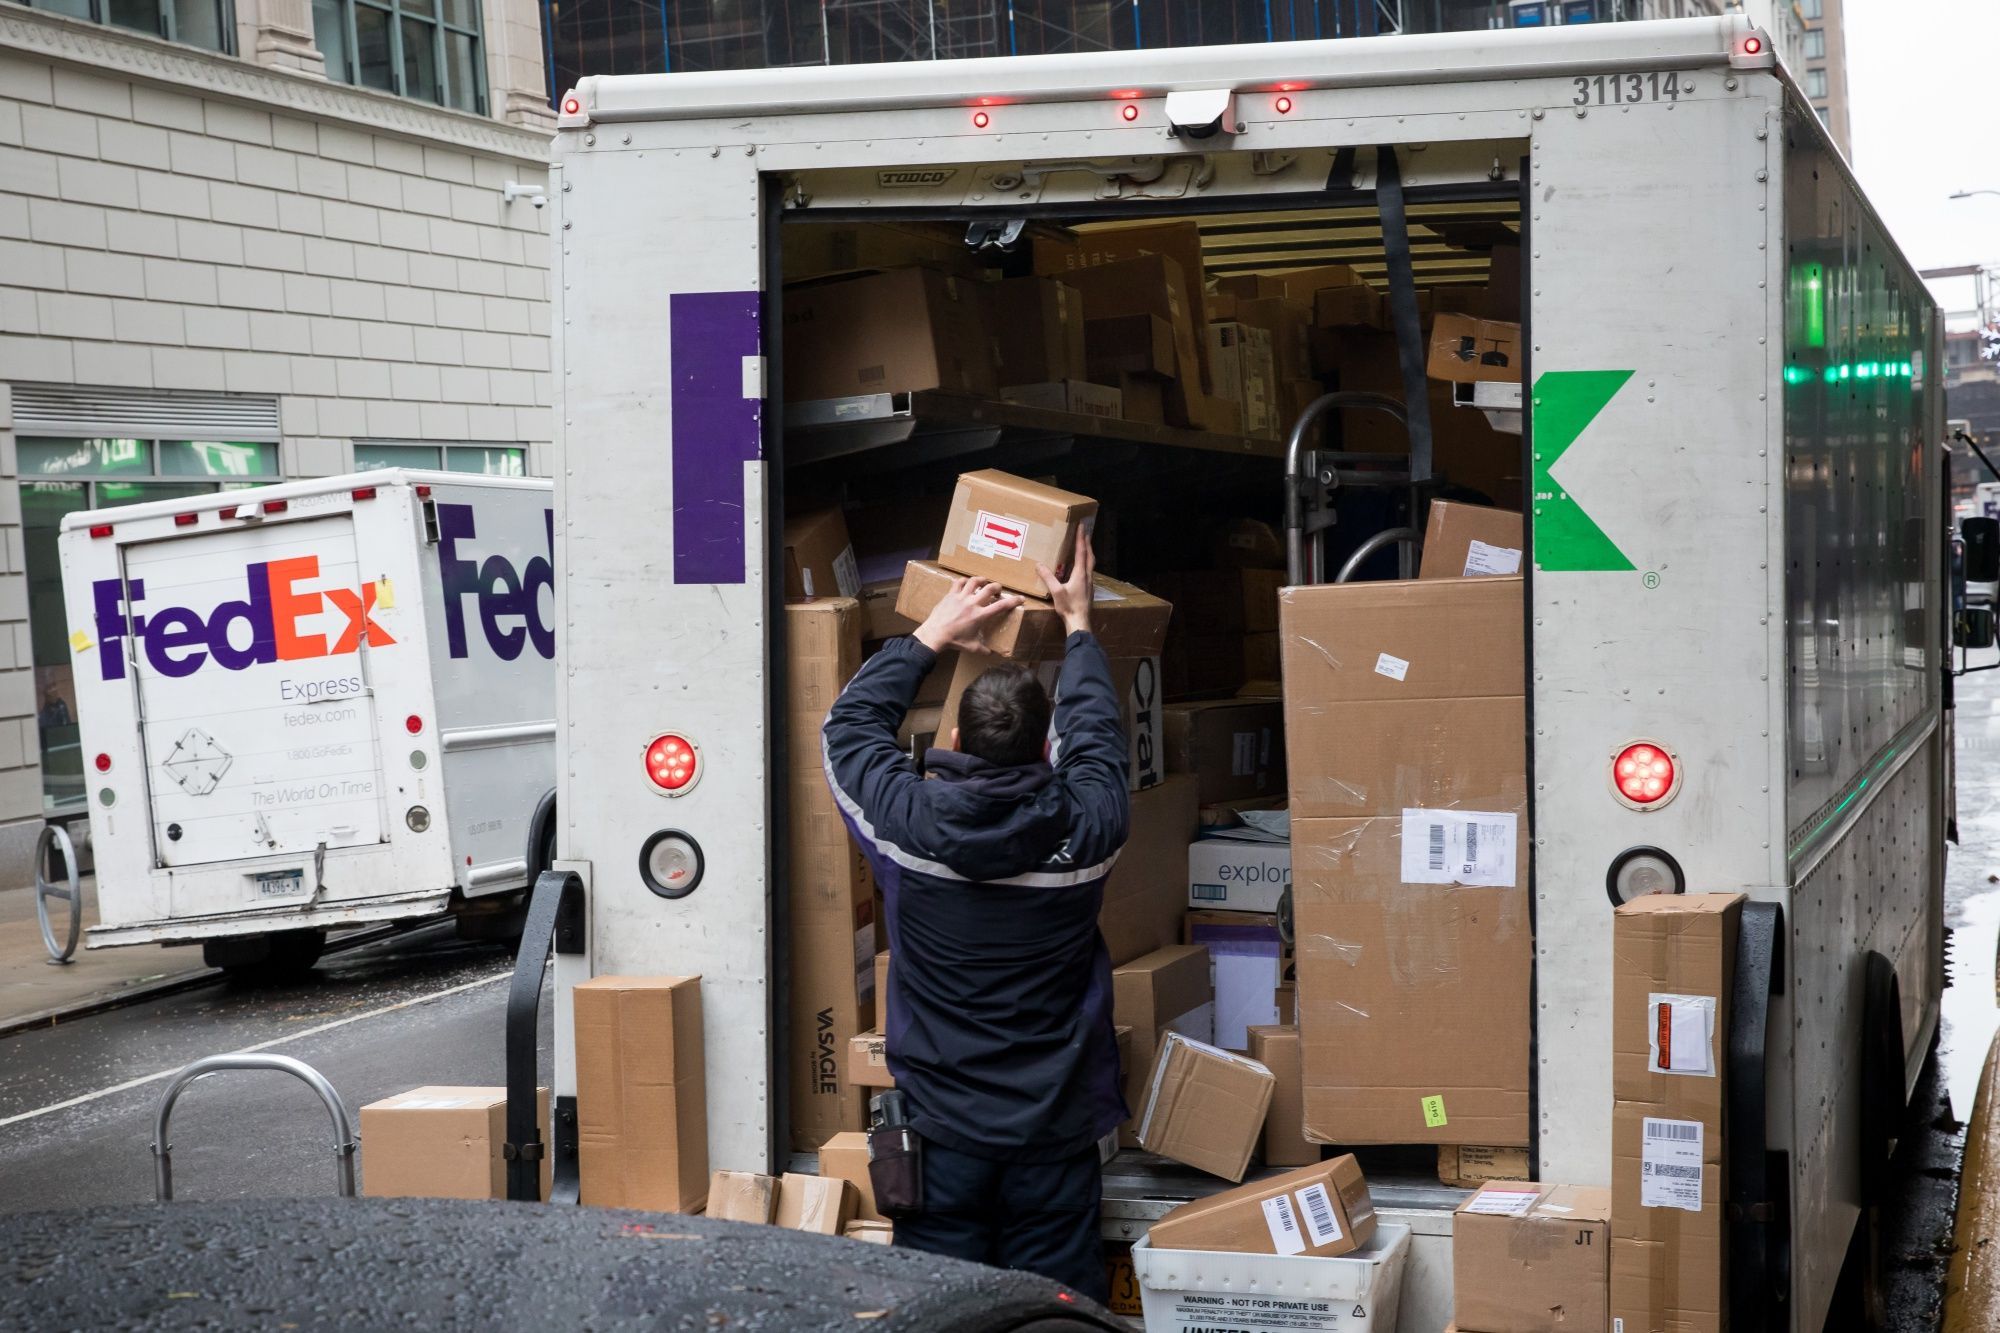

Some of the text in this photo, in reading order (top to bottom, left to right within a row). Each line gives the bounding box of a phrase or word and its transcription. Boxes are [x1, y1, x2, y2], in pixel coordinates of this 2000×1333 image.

[1573, 72, 1679, 106] 311314
[883, 172, 945, 184] TODCO
[92, 554, 398, 681] FedEx
[280, 677, 360, 704] Express
[284, 708, 356, 728] fedex.com
[251, 781, 373, 806] The World On Time
[817, 1006, 838, 1094] VASAGLE
[1575, 1230, 1594, 1246] JT
[1184, 1296, 1224, 1305] WARNING
[1273, 1302, 1308, 1310] PRIVATE
